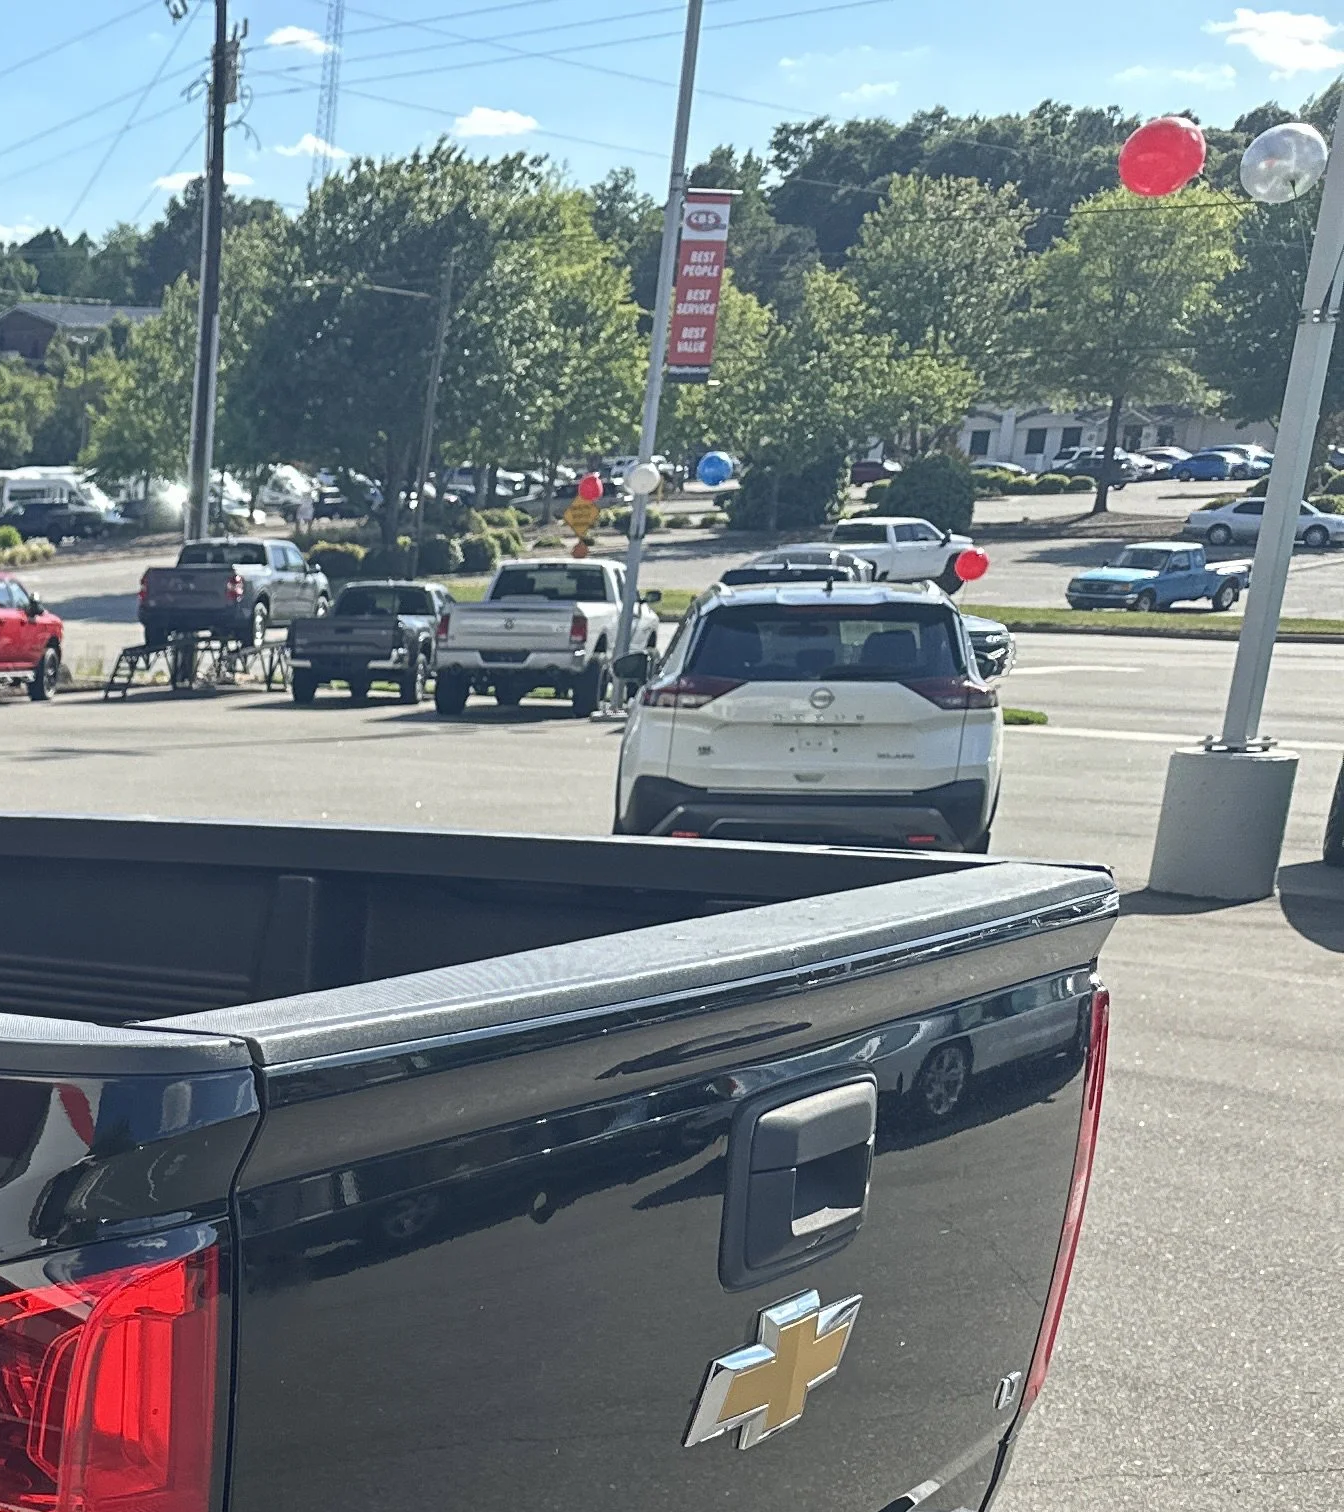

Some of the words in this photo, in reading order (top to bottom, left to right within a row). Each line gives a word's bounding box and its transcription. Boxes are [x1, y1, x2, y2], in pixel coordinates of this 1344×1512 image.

[689, 250, 717, 263] BEST
[681, 264, 721, 278] PEOPLE
[685, 288, 712, 301] BEST
[675, 302, 717, 316] SERVICE
[681, 326, 708, 340] BEST
[676, 340, 708, 353] VALUE
